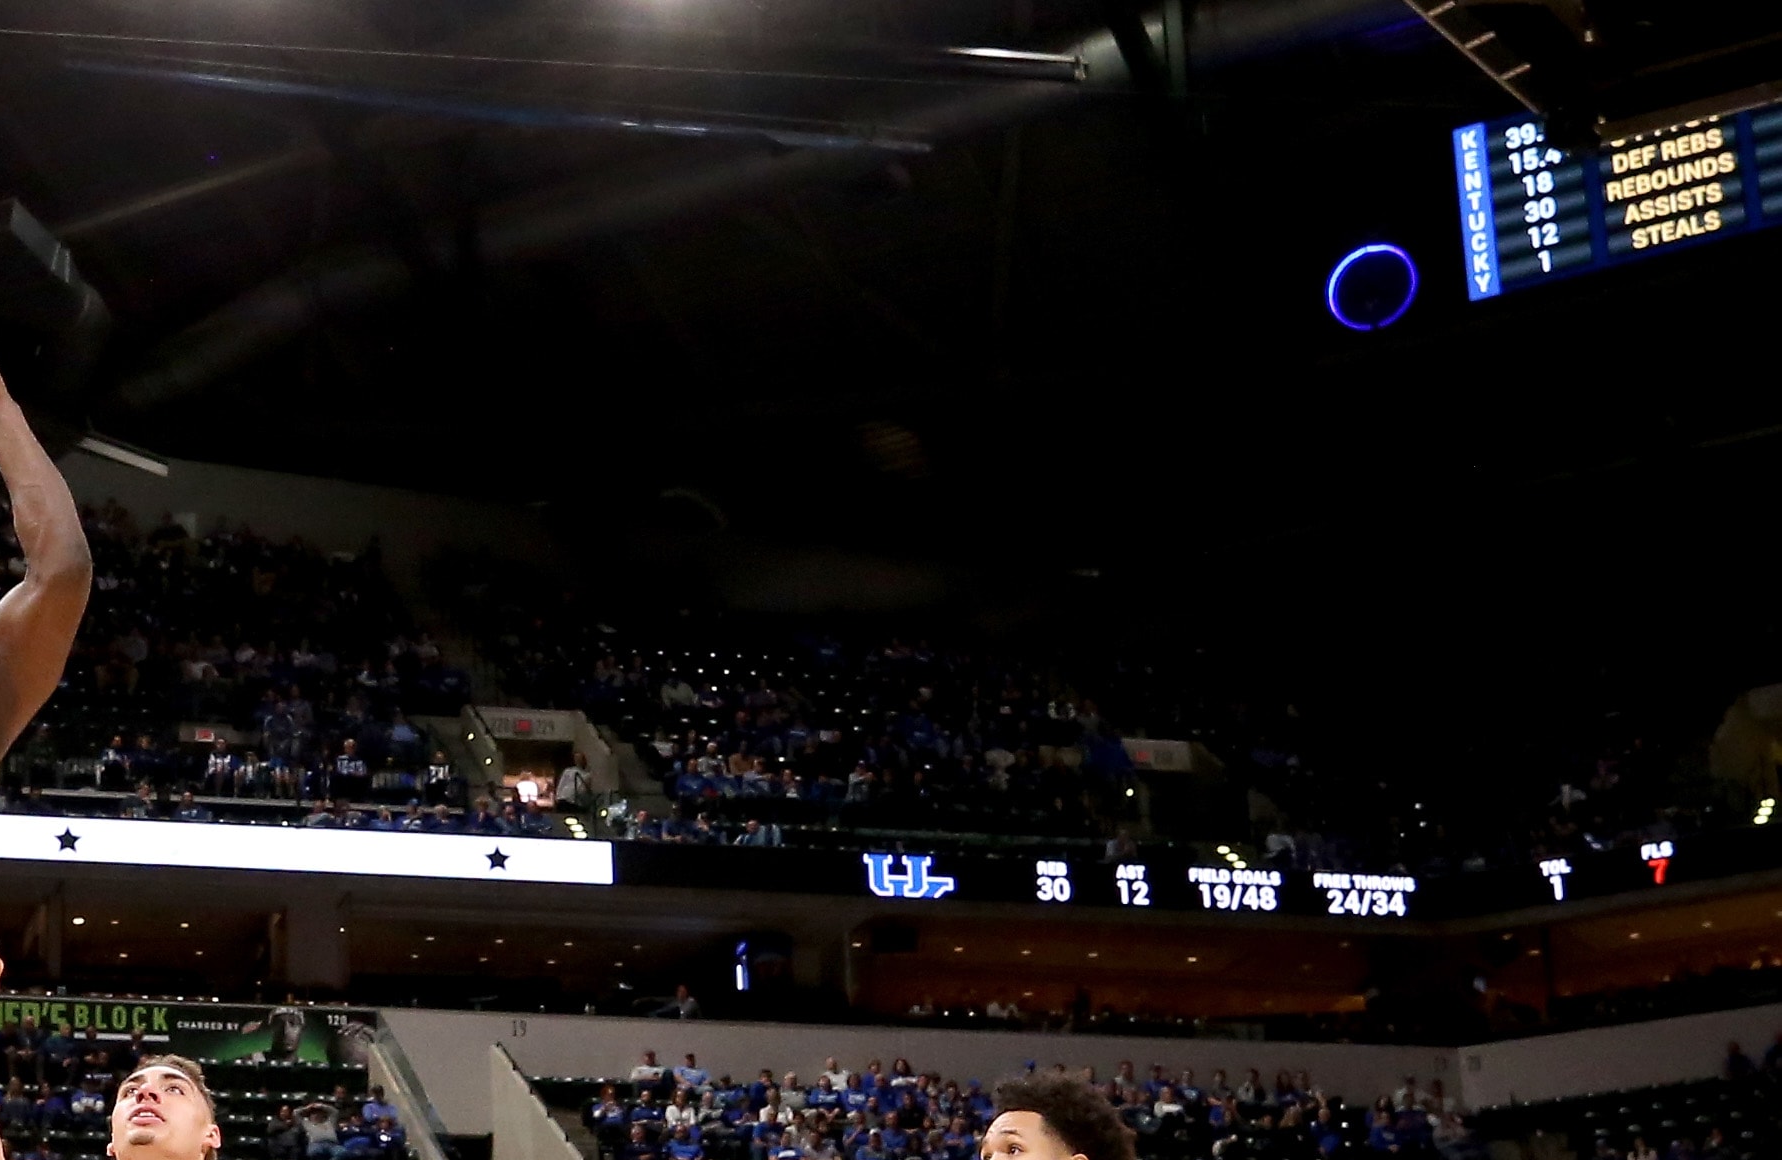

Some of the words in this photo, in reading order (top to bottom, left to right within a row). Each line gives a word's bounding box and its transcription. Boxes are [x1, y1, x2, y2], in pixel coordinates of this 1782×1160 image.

[1504, 123, 1545, 149] 39.
[1611, 140, 1655, 173] DEF
[1661, 129, 1723, 162] REBS
[1522, 171, 1554, 195] 18
[1606, 152, 1737, 202] REBOUNDS
[1460, 131, 1491, 294] KENTUCKY
[1523, 197, 1557, 224] 30
[1624, 183, 1723, 225] ASSISTS
[1528, 222, 1560, 248] 12
[1631, 211, 1722, 250] STEALS
[1538, 250, 1552, 273] 1
[1641, 841, 1674, 860] FLS
[1036, 860, 1068, 876] REB
[1116, 864, 1146, 880] AST
[1188, 867, 1230, 884] FIELD
[1232, 869, 1282, 887] GOALS
[1539, 858, 1572, 876] TOL
[1647, 859, 1670, 885] 7
[1036, 876, 1071, 902] 30
[1116, 880, 1150, 906] 12
[1313, 872, 1351, 889] FREE
[1352, 874, 1415, 892] THROWS
[1549, 875, 1564, 901] 1
[1198, 884, 1278, 911] 19/48
[1327, 889, 1406, 917] 24/34
[74, 1003, 169, 1032] BLOCK
